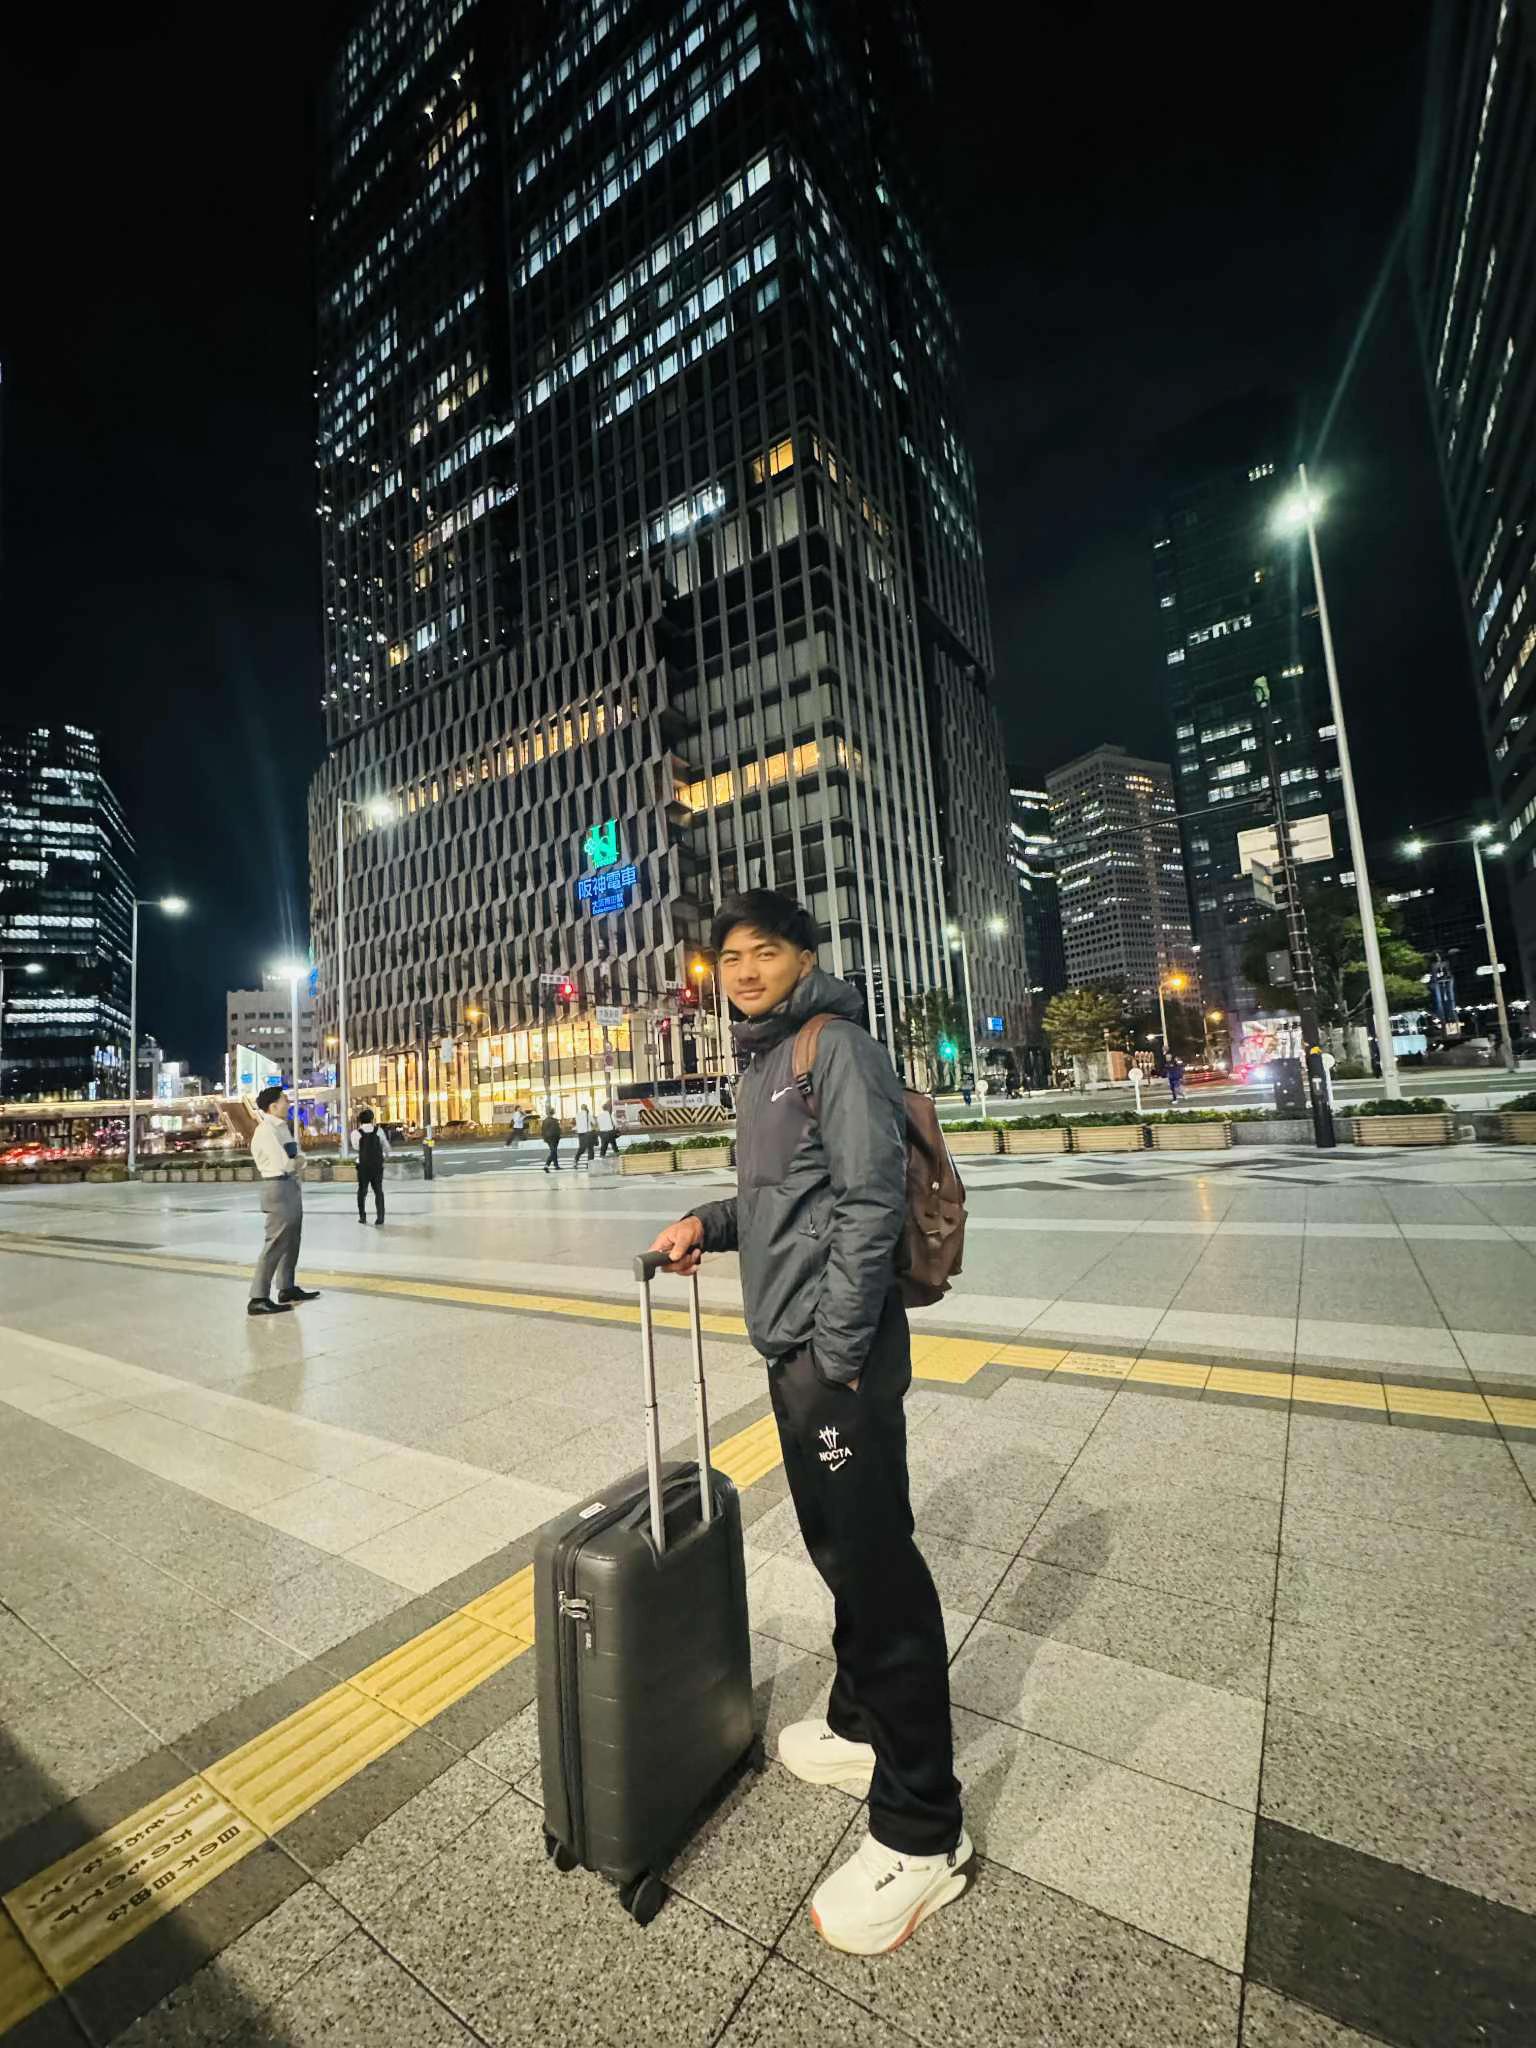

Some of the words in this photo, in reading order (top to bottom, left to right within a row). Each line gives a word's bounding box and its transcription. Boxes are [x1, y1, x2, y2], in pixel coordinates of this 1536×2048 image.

[579, 866, 637, 900] 阪神電車
[819, 1447, 852, 1462] NOCTA
[107, 1825, 241, 1922] 目の不自由な
